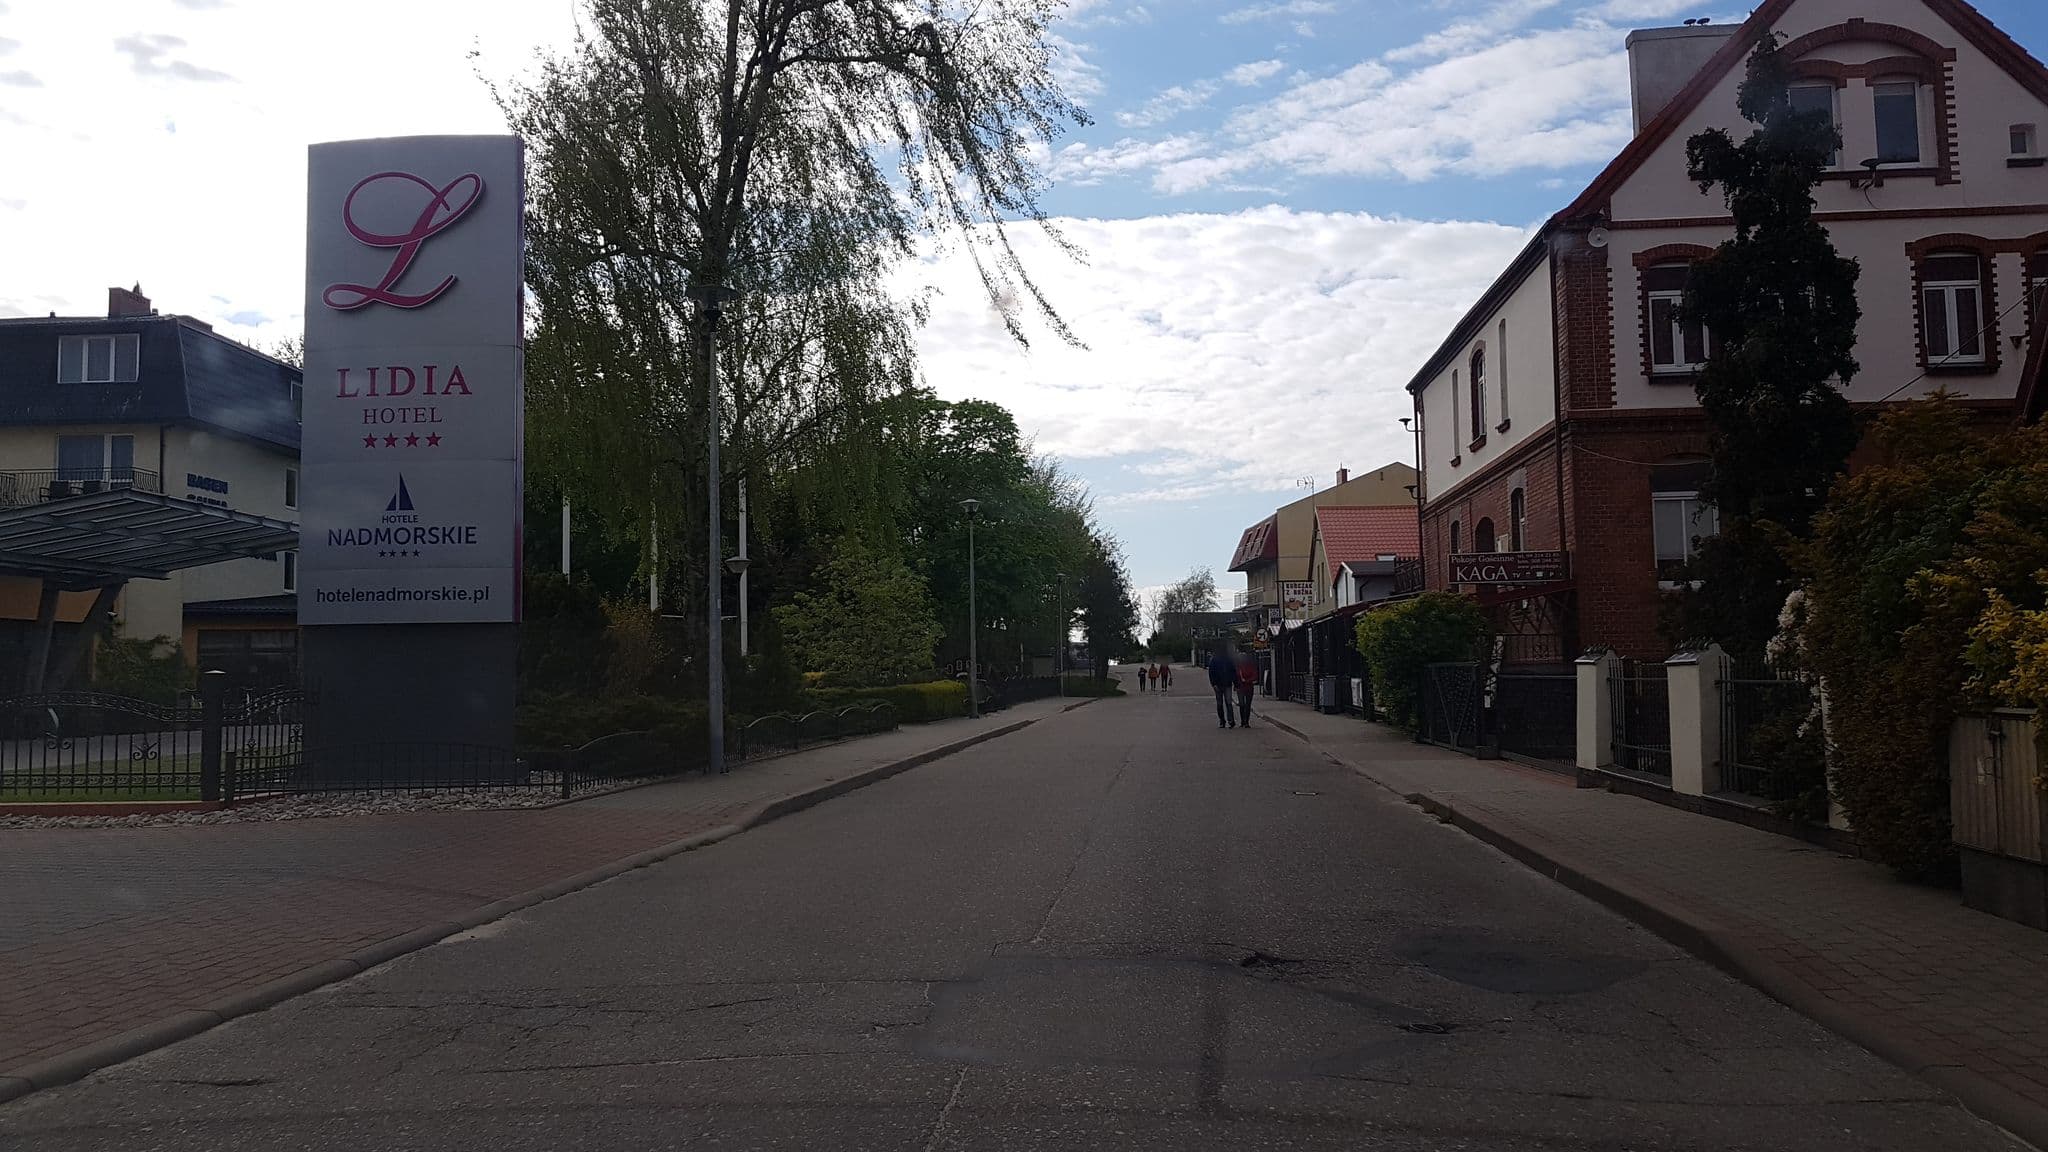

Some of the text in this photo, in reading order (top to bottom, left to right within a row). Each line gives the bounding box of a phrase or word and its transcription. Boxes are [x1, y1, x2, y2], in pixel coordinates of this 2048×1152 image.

[337, 365, 473, 398] LIDIA
[363, 406, 443, 424] HOTEL
[382, 513, 419, 524] HOTELE
[328, 525, 477, 547] NADMORSKIE
[1456, 565, 1508, 581] KAGA
[316, 585, 490, 605] hotelenadmorskie.pl
